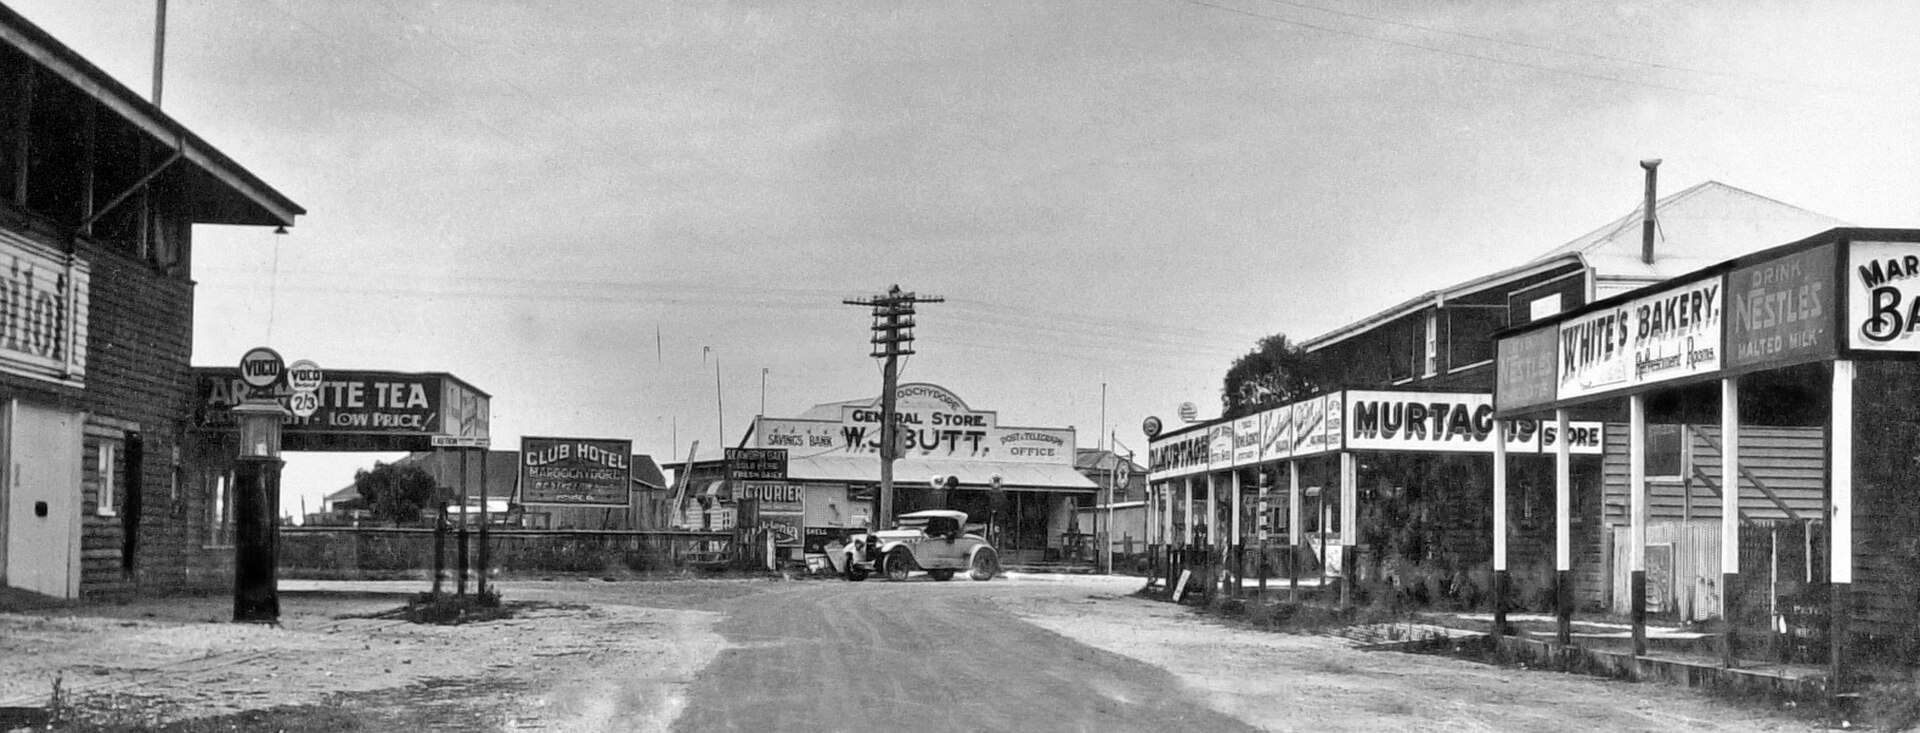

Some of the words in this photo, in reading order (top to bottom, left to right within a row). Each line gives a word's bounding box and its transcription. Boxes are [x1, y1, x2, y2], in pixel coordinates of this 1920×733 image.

[1751, 260, 1802, 287] DRINK
[1857, 254, 1920, 291] MAR
[1561, 307, 1629, 378] WHITE'S
[1737, 334, 1783, 359] MALTED
[1788, 329, 1818, 349] MILK
[244, 359, 279, 377] VOCO
[291, 369, 321, 381] VOCO
[294, 394, 315, 411] 2/3
[374, 382, 429, 409] TEA
[329, 411, 369, 426] LOW
[372, 411, 437, 431] PRICE!
[852, 408, 923, 425] GENRAL
[767, 433, 804, 447] SAVINGS
[808, 434, 833, 447] BANK
[999, 432, 1020, 446] POST
[1543, 426, 1600, 447] SORE
[526, 443, 570, 465] CLUB
[577, 443, 627, 468] HOTEL
[1010, 446, 1055, 456] OFFICE
[745, 484, 803, 502] COURIER
